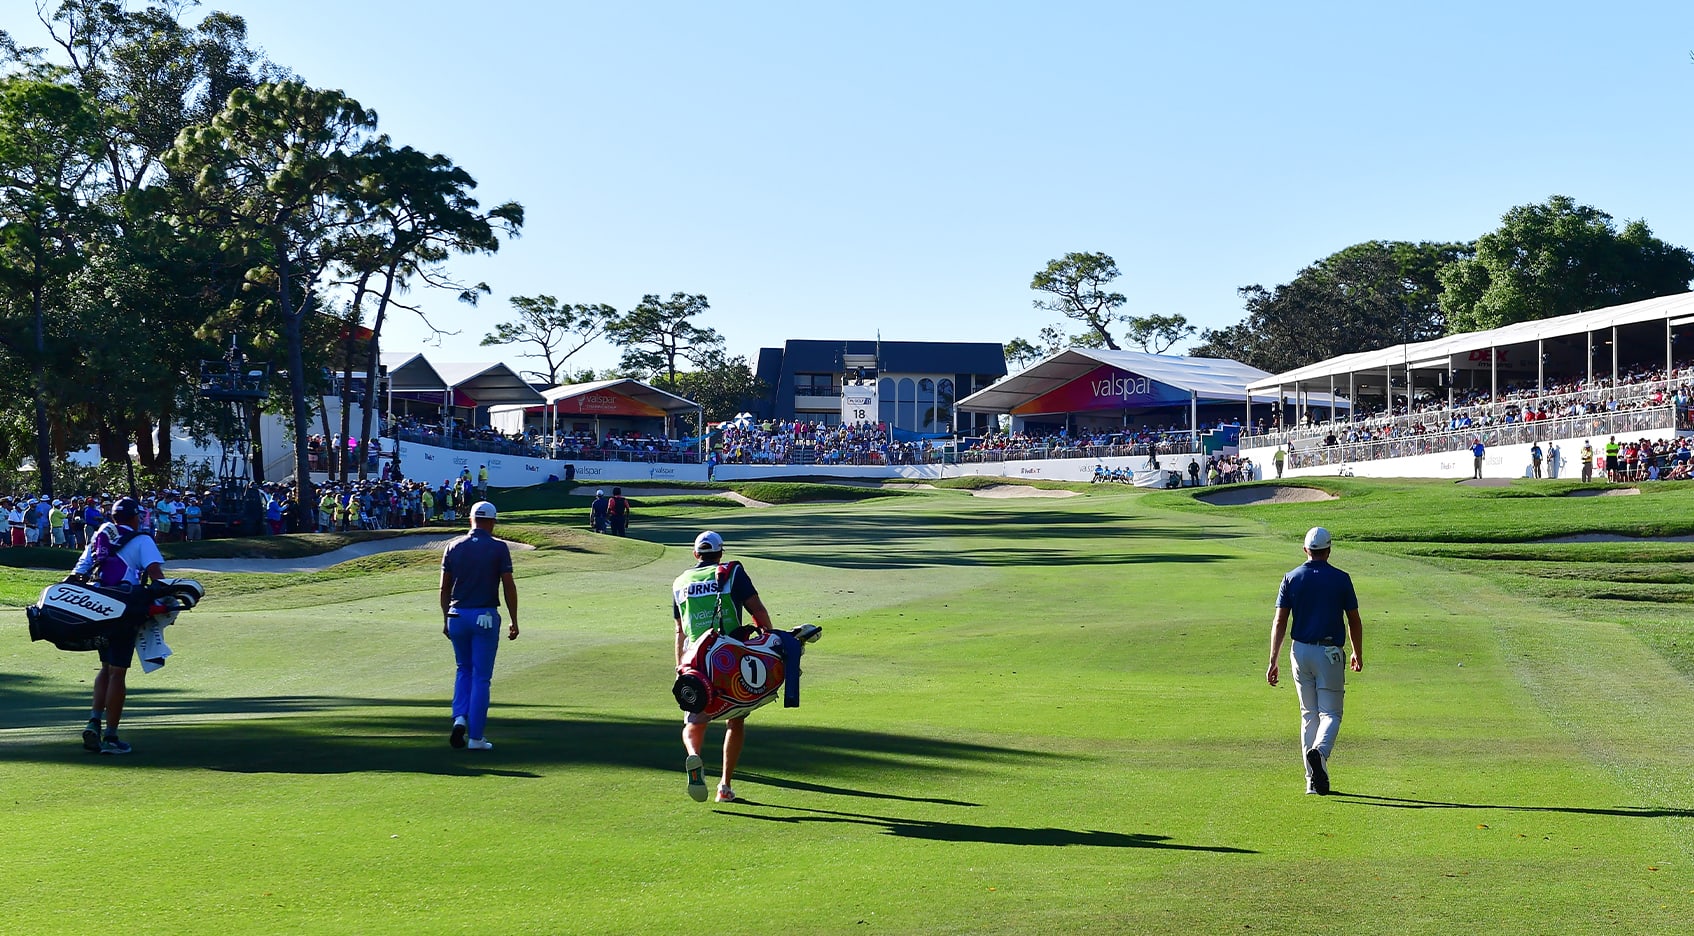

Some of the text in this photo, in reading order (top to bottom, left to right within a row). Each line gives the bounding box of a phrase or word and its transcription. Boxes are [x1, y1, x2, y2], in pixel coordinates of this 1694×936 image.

[1468, 349, 1509, 361] DEX
[1091, 372, 1151, 401] valspar
[586, 394, 617, 405] valspar
[853, 409, 866, 419] 18
[575, 466, 602, 476] valspar
[49, 587, 115, 617] Titleist
[748, 659, 758, 685] 1
